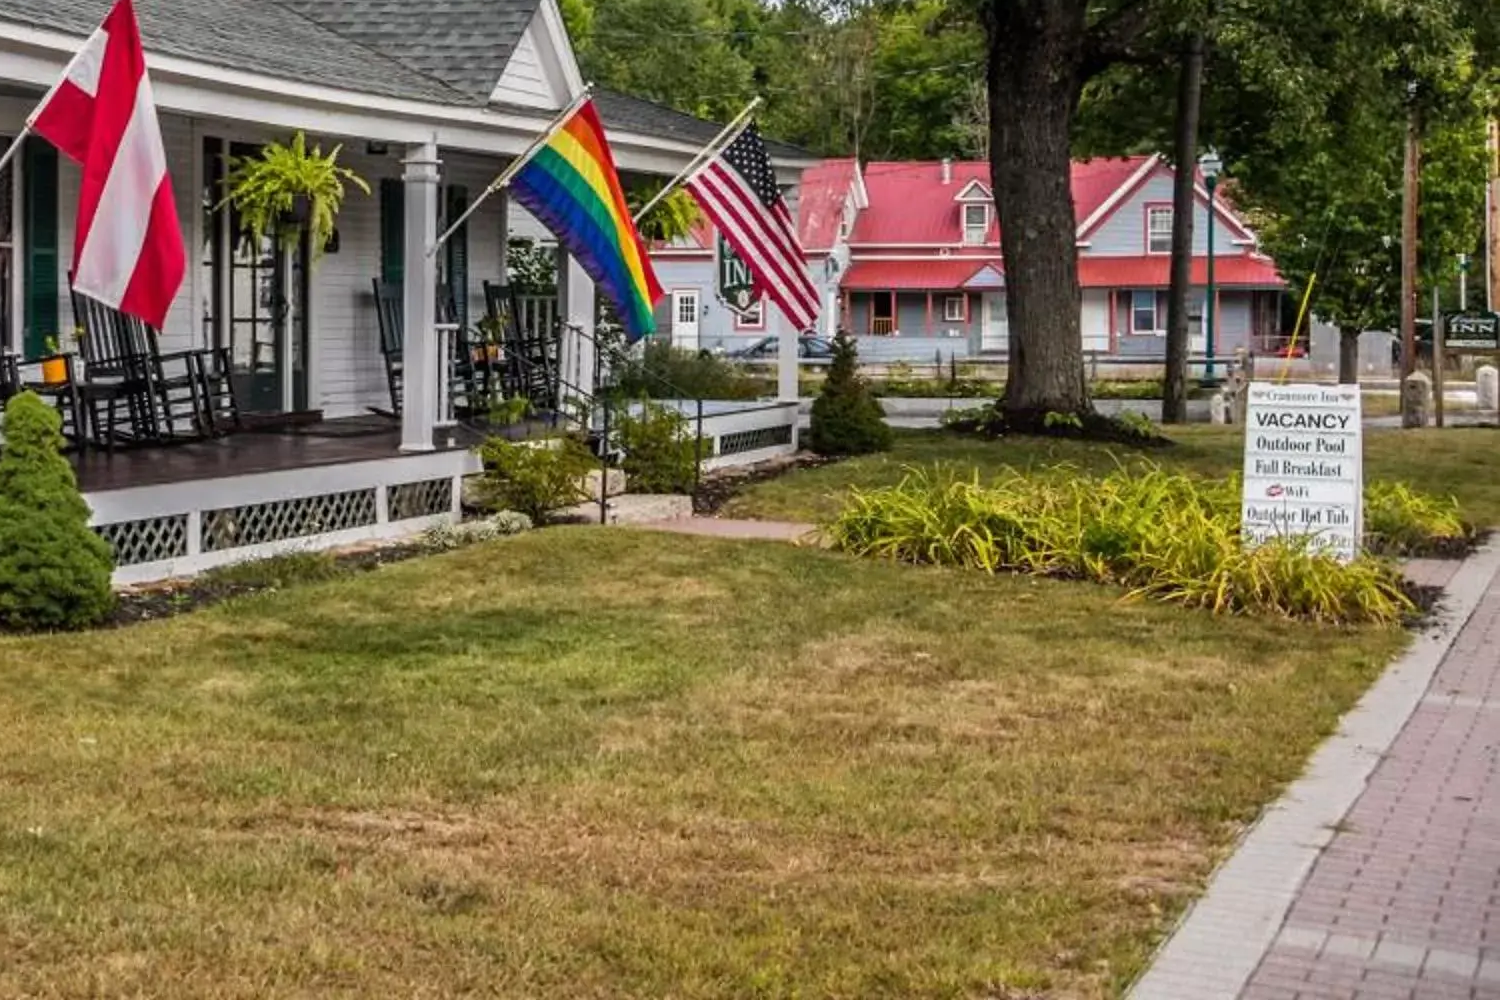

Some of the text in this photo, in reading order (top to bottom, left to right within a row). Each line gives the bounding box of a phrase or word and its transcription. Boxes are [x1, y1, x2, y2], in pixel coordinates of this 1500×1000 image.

[1451, 323, 1494, 333] INN
[1321, 390, 1339, 403] Inn
[1256, 412, 1350, 429] VACANCY
[1256, 436, 1345, 454] Outdoor Pool
[1255, 459, 1341, 477] Full Breakfast
[1247, 506, 1350, 525] Outdoor Hot Tub
